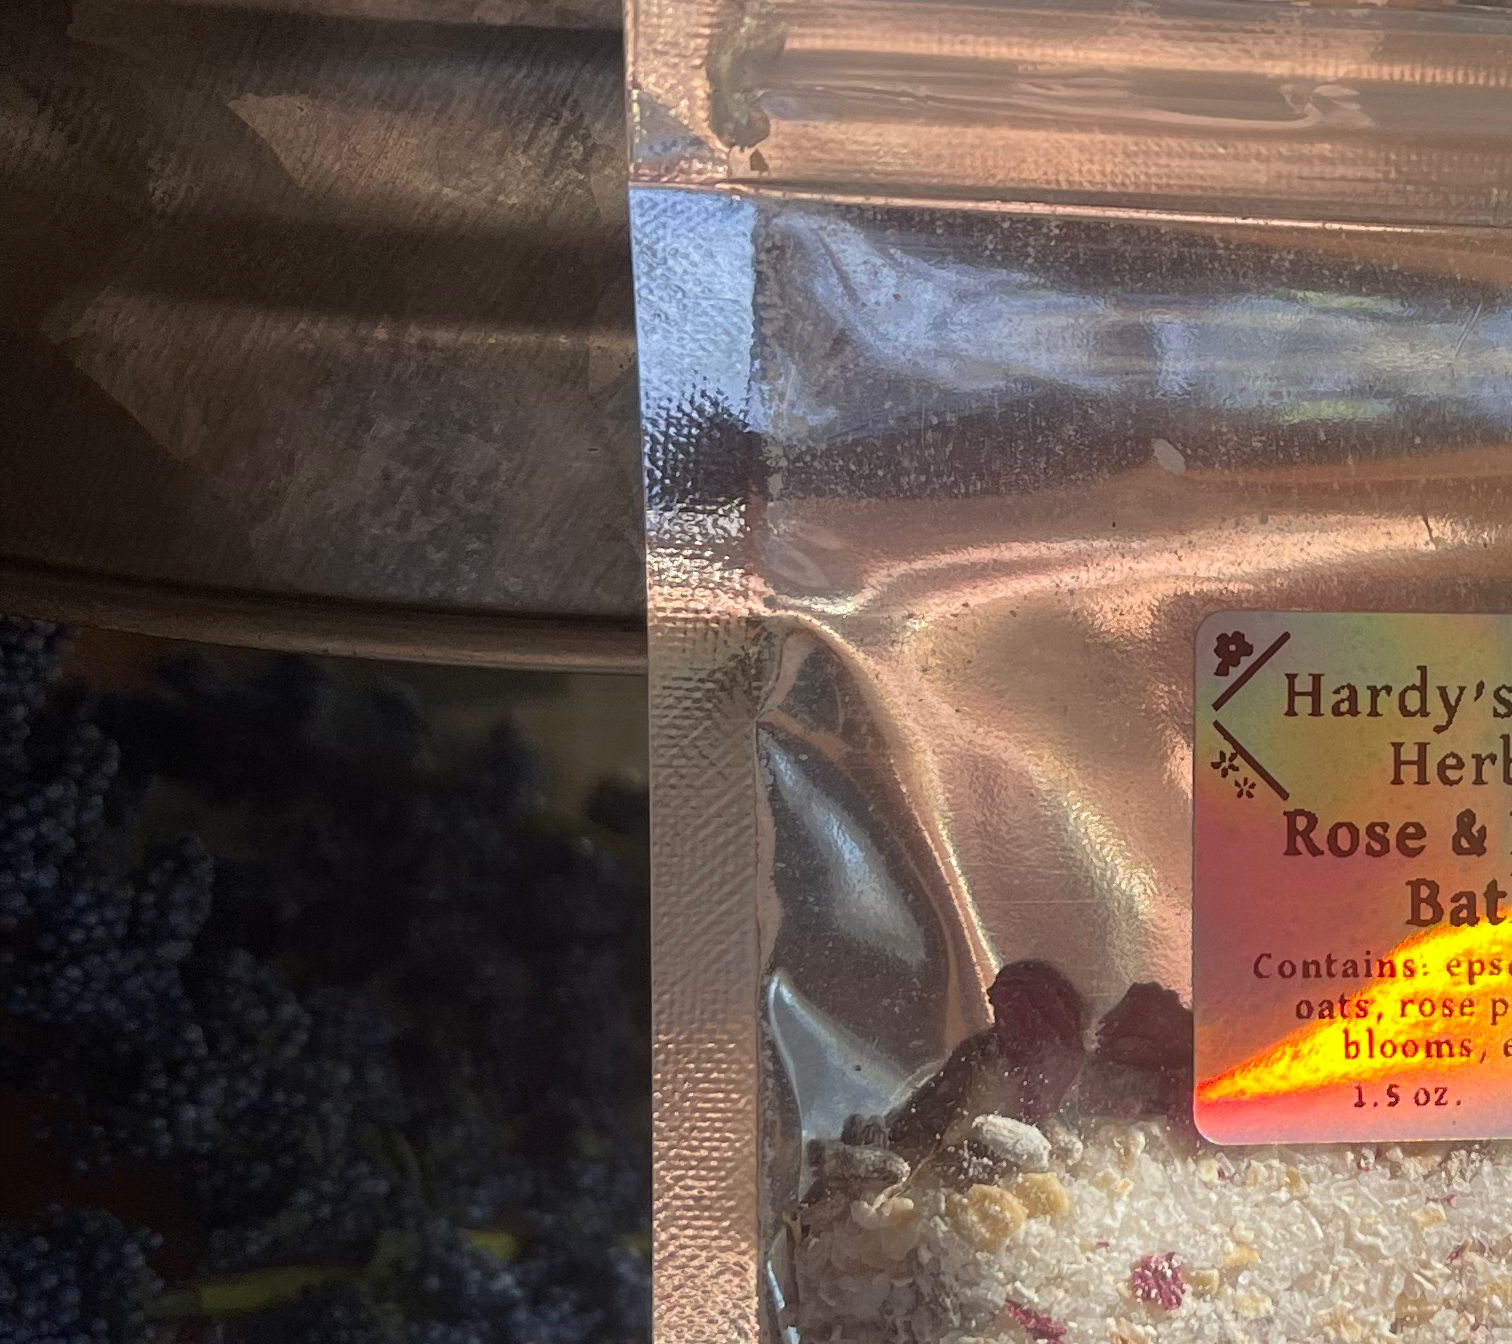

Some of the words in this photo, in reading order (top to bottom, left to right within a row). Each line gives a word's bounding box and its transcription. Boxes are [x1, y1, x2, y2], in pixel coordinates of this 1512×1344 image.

[1281, 809, 1428, 859] Rose
[1451, 809, 1488, 858] &
[1253, 950, 1429, 981] Contains:
[1294, 993, 1384, 1026] oats,
[1399, 992, 1475, 1021] rose
[1343, 1027, 1489, 1065] blooms,
[1352, 1083, 1401, 1110] 1.5
[1412, 1086, 1463, 1108] oz.
